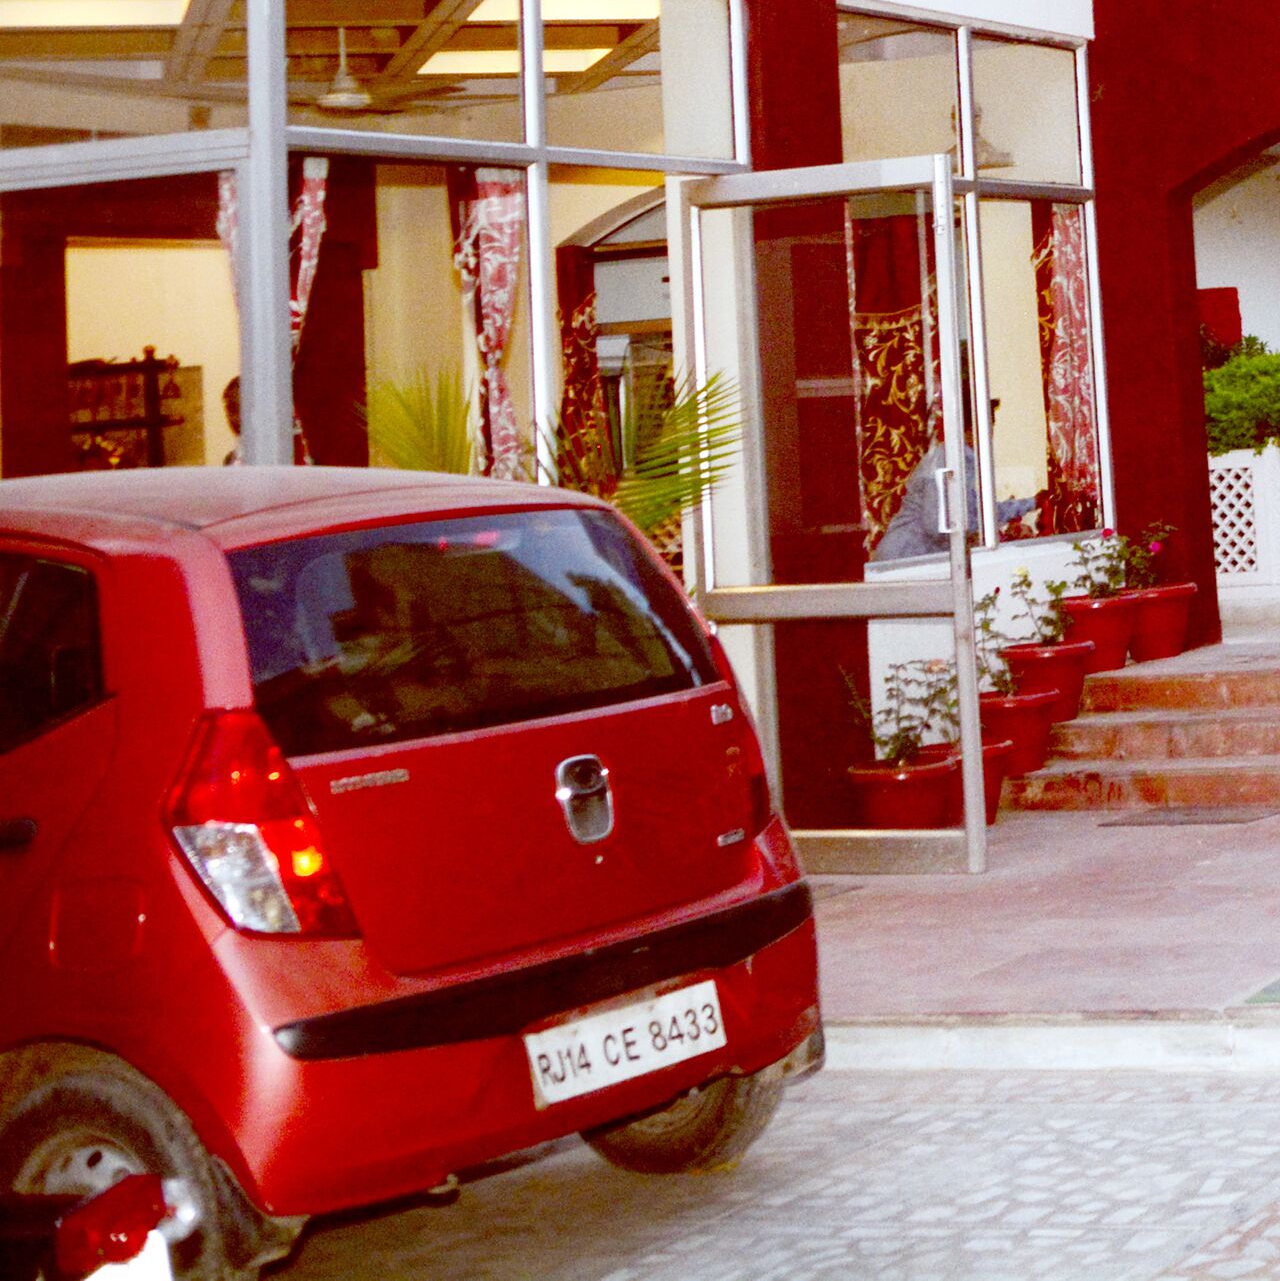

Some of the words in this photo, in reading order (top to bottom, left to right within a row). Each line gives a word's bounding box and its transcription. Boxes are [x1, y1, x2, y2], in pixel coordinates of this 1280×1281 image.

[537, 1043, 592, 1087] RJ14
[603, 1027, 640, 1066] CE
[648, 1004, 719, 1051] 8433
